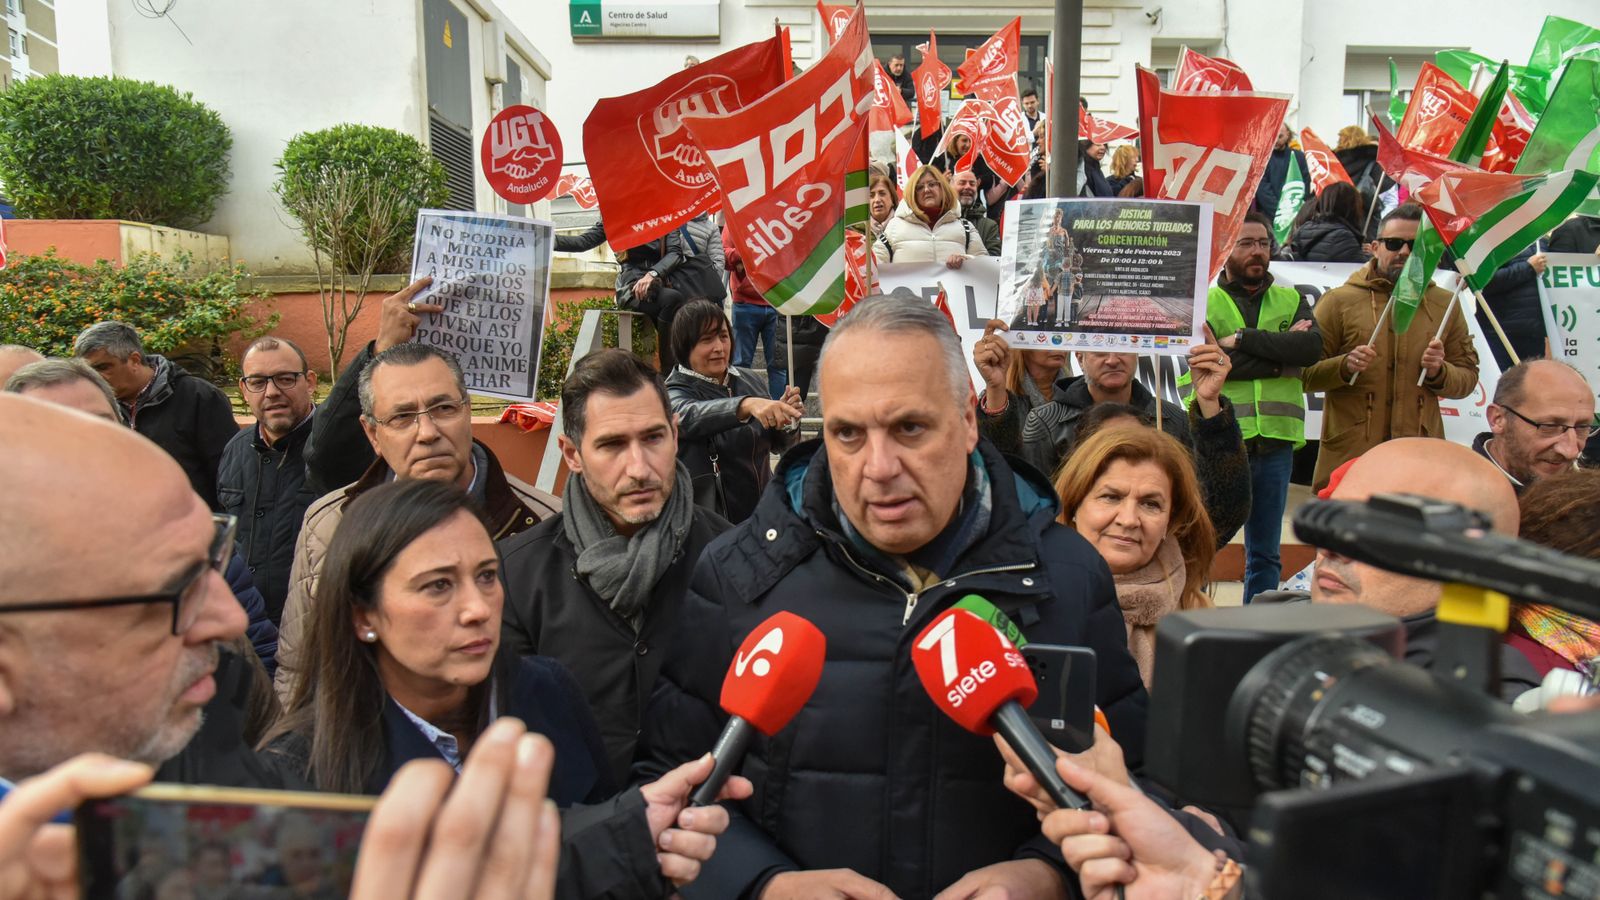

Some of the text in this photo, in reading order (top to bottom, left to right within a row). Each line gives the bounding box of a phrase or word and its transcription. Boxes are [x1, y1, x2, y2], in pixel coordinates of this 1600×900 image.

[653, 85, 729, 134] UGT
[992, 99, 1022, 143] UGT
[491, 111, 546, 158] UGT
[507, 176, 548, 194] Andalucía
[675, 168, 715, 184] Anda
[1073, 219, 1193, 233] PARA LOS MENORES TUTELADOS
[1119, 209, 1153, 219] JUSTICIA
[430, 225, 526, 248] NO PODRÍA
[1097, 234, 1168, 247] CONCENTRACIÓN
[448, 241, 506, 259] MIRAR
[1082, 247, 1112, 255] Viernes,
[426, 252, 526, 276] A MIS HIJOS
[428, 266, 523, 290] A LOS OJOS
[439, 281, 525, 305] DECIRLES
[426, 294, 522, 321] QUE ELLOS
[430, 313, 517, 339] VIVEN ASÍ
[416, 329, 522, 356] PORQUE YO
[466, 354, 527, 373] ANIMÉ
[463, 372, 511, 388] CHAR
[917, 614, 959, 687] 7
[947, 660, 997, 708] siete
